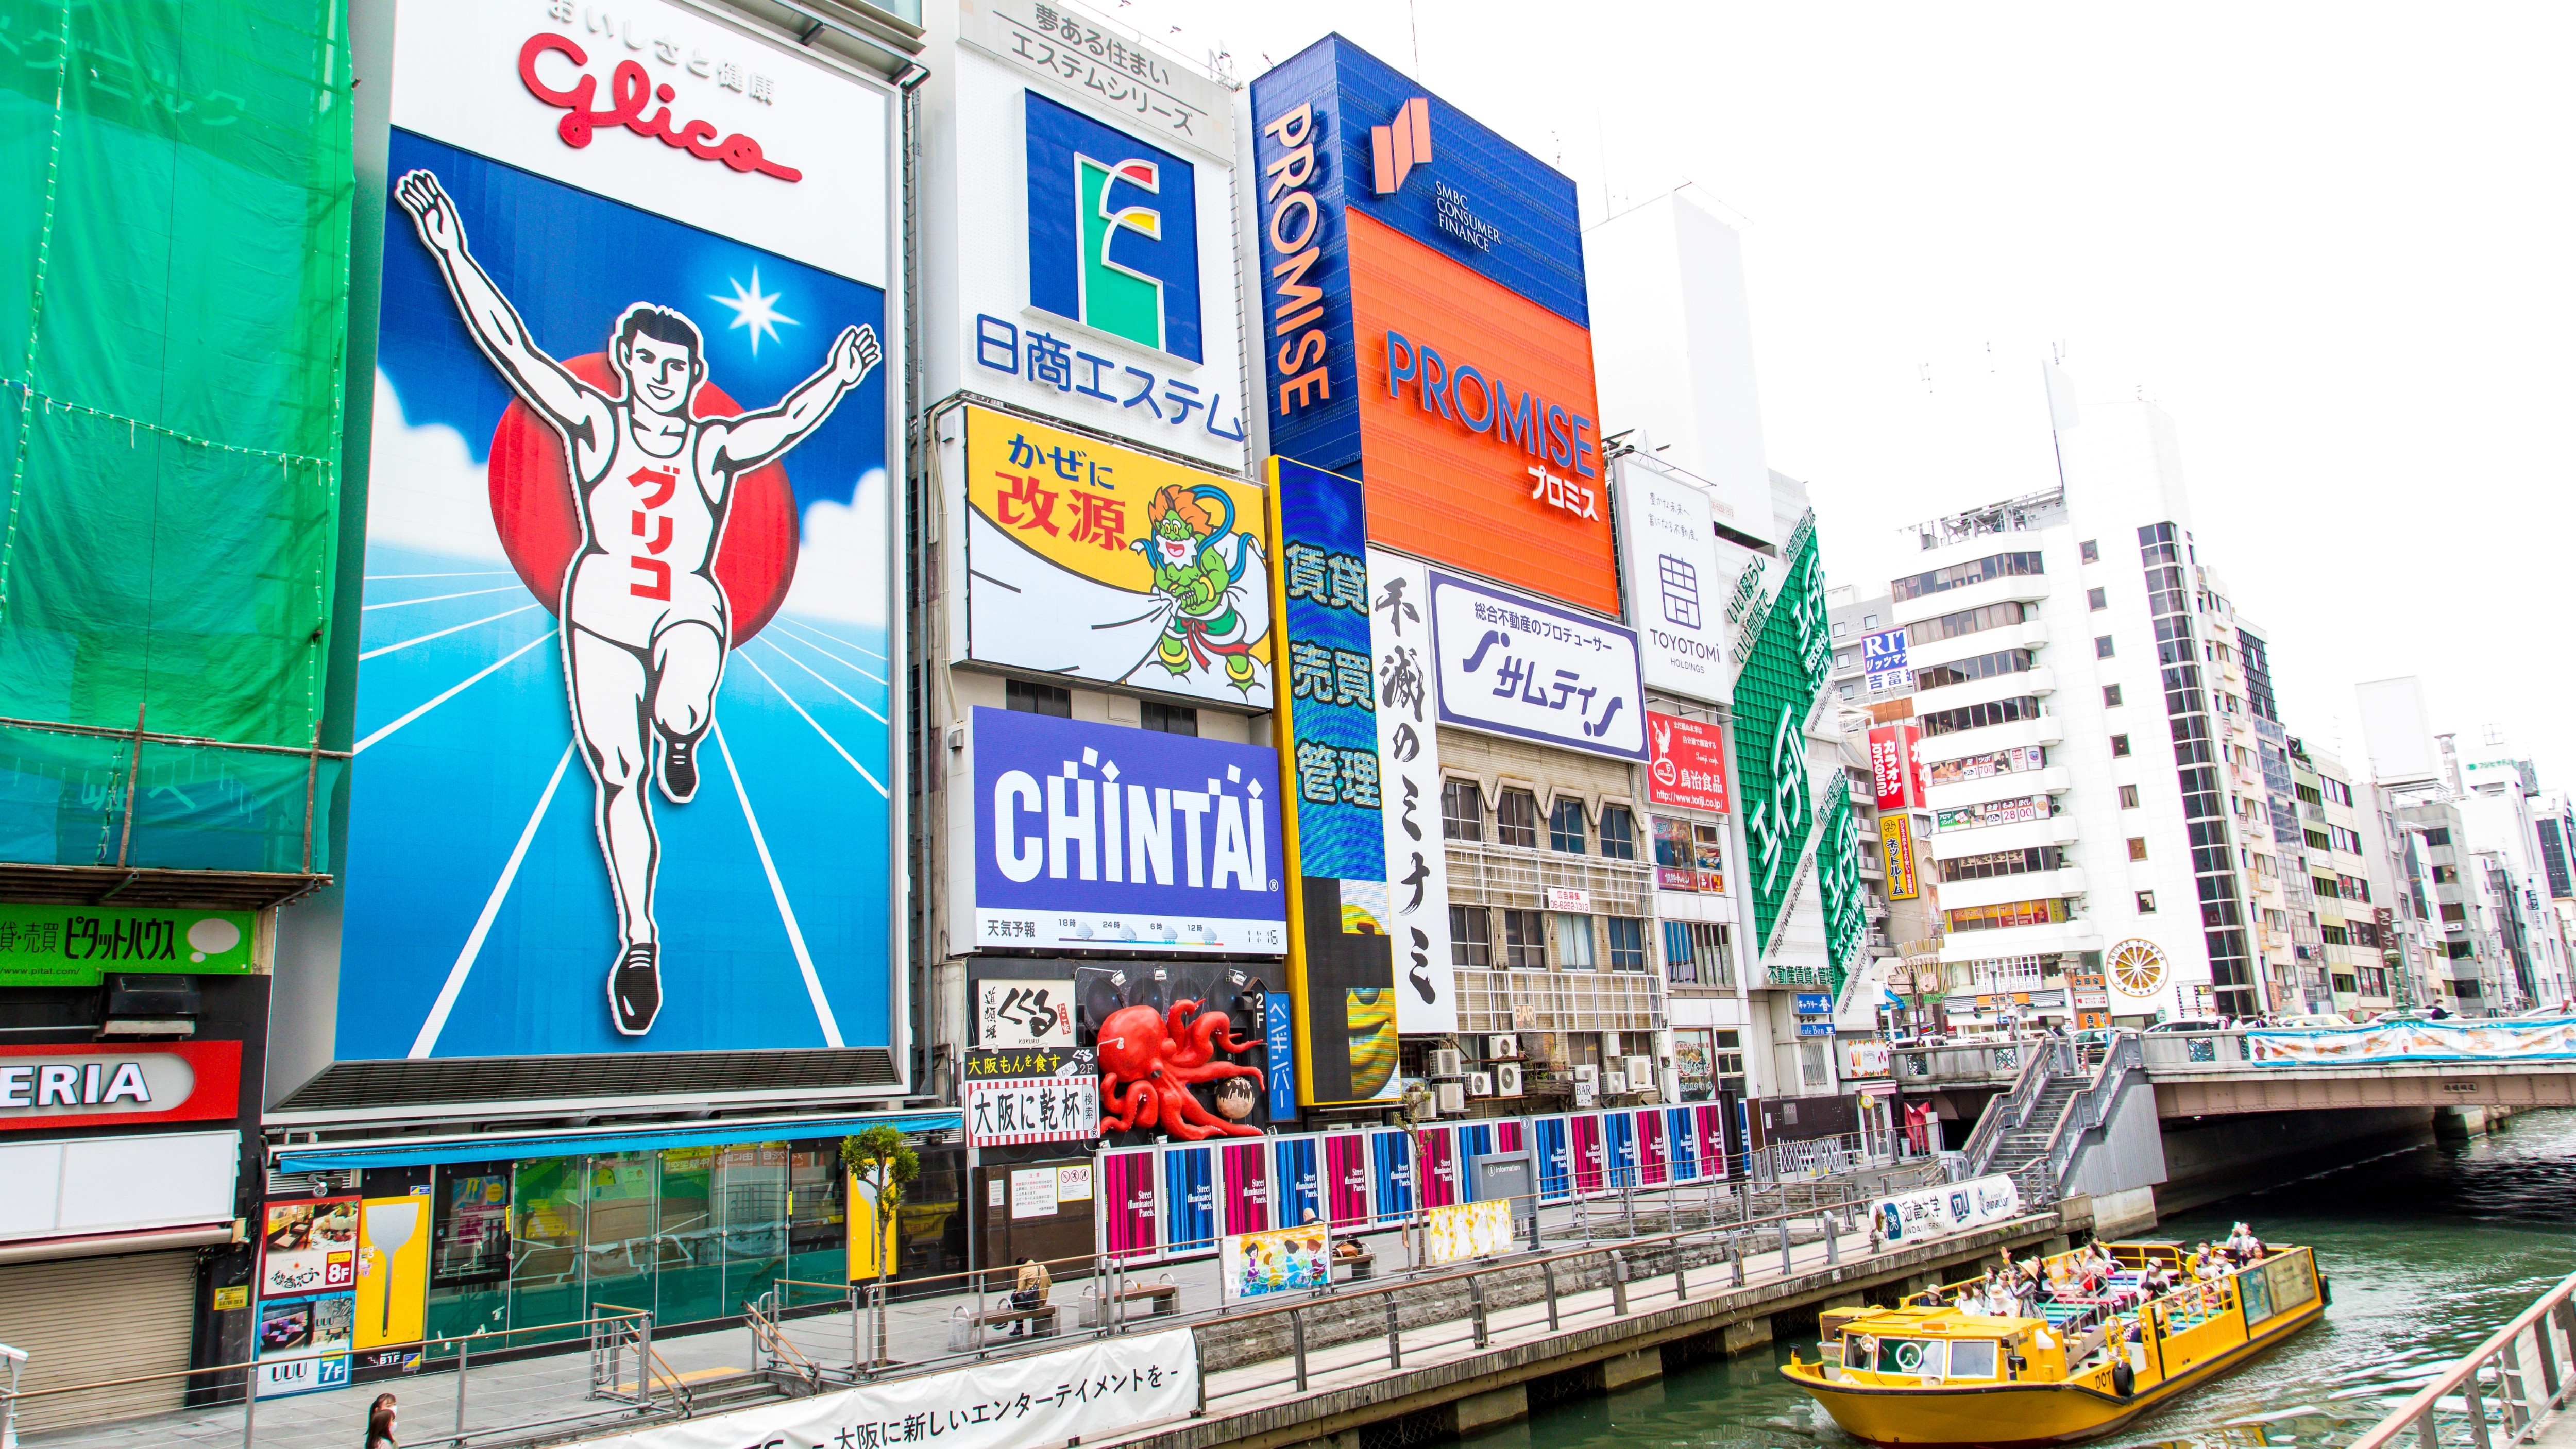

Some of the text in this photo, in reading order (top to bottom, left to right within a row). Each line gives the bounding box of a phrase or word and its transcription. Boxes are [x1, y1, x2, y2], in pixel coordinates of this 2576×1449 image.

[547, 0, 776, 105] おいしさと健康
[1036, 3, 1170, 86] 夢ある住まい
[1011, 30, 1194, 136] エステムシリーズ
[518, 32, 802, 182] Glico
[1435, 181, 1468, 210] SMBC
[1437, 198, 1501, 245] CONSUMER
[1438, 212, 1490, 253] FINANCE
[1265, 103, 1330, 416] PROMISE
[976, 313, 1244, 444] 日商エステム
[1386, 330, 1595, 480] PROMISE
[1007, 433, 1115, 490] かぜに
[995, 470, 1127, 551] 改源
[1527, 465, 1600, 522] プロミス
[626, 465, 680, 602] グリコ
[1285, 541, 1369, 616] 賃貸
[1726, 554, 1766, 624] いい暮らし
[1790, 551, 1827, 649] エイブル
[1474, 601, 1612, 652] 総合不動産のプロデューサー
[1732, 587, 1772, 665] いい部屋で
[1670, 657, 1705, 674] HOLDINGS
[1803, 627, 1829, 675] 株式会社
[1291, 640, 1375, 712] 売買
[1493, 655, 1597, 715] サムティ
[1806, 655, 1832, 700] エイブル
[1809, 678, 1836, 732] www.able.co.jp
[1296, 741, 1381, 809] 管理
[1872, 743, 1888, 797] JOYSOUND
[1884, 740, 1902, 795] カラオケ
[1375, 577, 1436, 1005] 不滅のミナミ
[1656, 789, 1723, 810] http://www.toriji.co.jp/
[1748, 713, 1809, 876] エイブル
[995, 746, 1267, 892] CHINTAI
[1822, 815, 1859, 916] エイブル
[1885, 838, 1905, 896] ネットルーム
[1058, 918, 1076, 927] 18時
[1102, 920, 1121, 929] 24時
[1769, 851, 1814, 958] http://www.able.co.jp
[1955, 903, 2024, 920] タイ古式マッサージ
[64, 916, 176, 961] ピタットハウス
[987, 919, 1036, 939] 天気予報
[1247, 929, 1279, 945] 11:16
[1768, 964, 1836, 986] 不動産賃貸・管理
[2108, 940, 2164, 965] FRUITS TOWER
[1798, 1000, 1818, 1009] ギャラリー
[2115, 979, 2163, 995] フルーツタワー
[984, 986, 997, 1040] 道頓堀
[997, 988, 1058, 1037] くくる
[1059, 1005, 1071, 1034] たこ家
[1515, 1005, 1534, 1021] BAR
[1802, 1025, 1824, 1035] café Bon
[968, 1053, 1061, 1076] 大阪もんを食す
[1073, 1049, 1094, 1063] くくる
[1079, 1064, 1094, 1075] 2F
[1269, 1002, 1291, 1109] ペンギンバー
[974, 1087, 1080, 1137] 大阪に乾杯
[1084, 1093, 1093, 1120] 検索
[1576, 1084, 1591, 1096] BAR
[1197, 1185, 1210, 1193] Street
[1252, 1179, 1264, 1187] Street
[1304, 1173, 1315, 1182] Street
[1352, 1168, 1363, 1177] Street
[1496, 1164, 1520, 1173] information
[1138, 1190, 1152, 1200] Street
[1139, 1208, 1155, 1218] Panels.
[1198, 1202, 1213, 1211] Panels.
[1253, 1196, 1267, 1204] Panels.
[1899, 1195, 1941, 1223] 近畿大学
[328, 1263, 350, 1283] 8F
[322, 1360, 344, 1382] 7F
[379, 1355, 400, 1366] B1F
[835, 1364, 1162, 1449] 大阪に新しいエンターテイメントを
